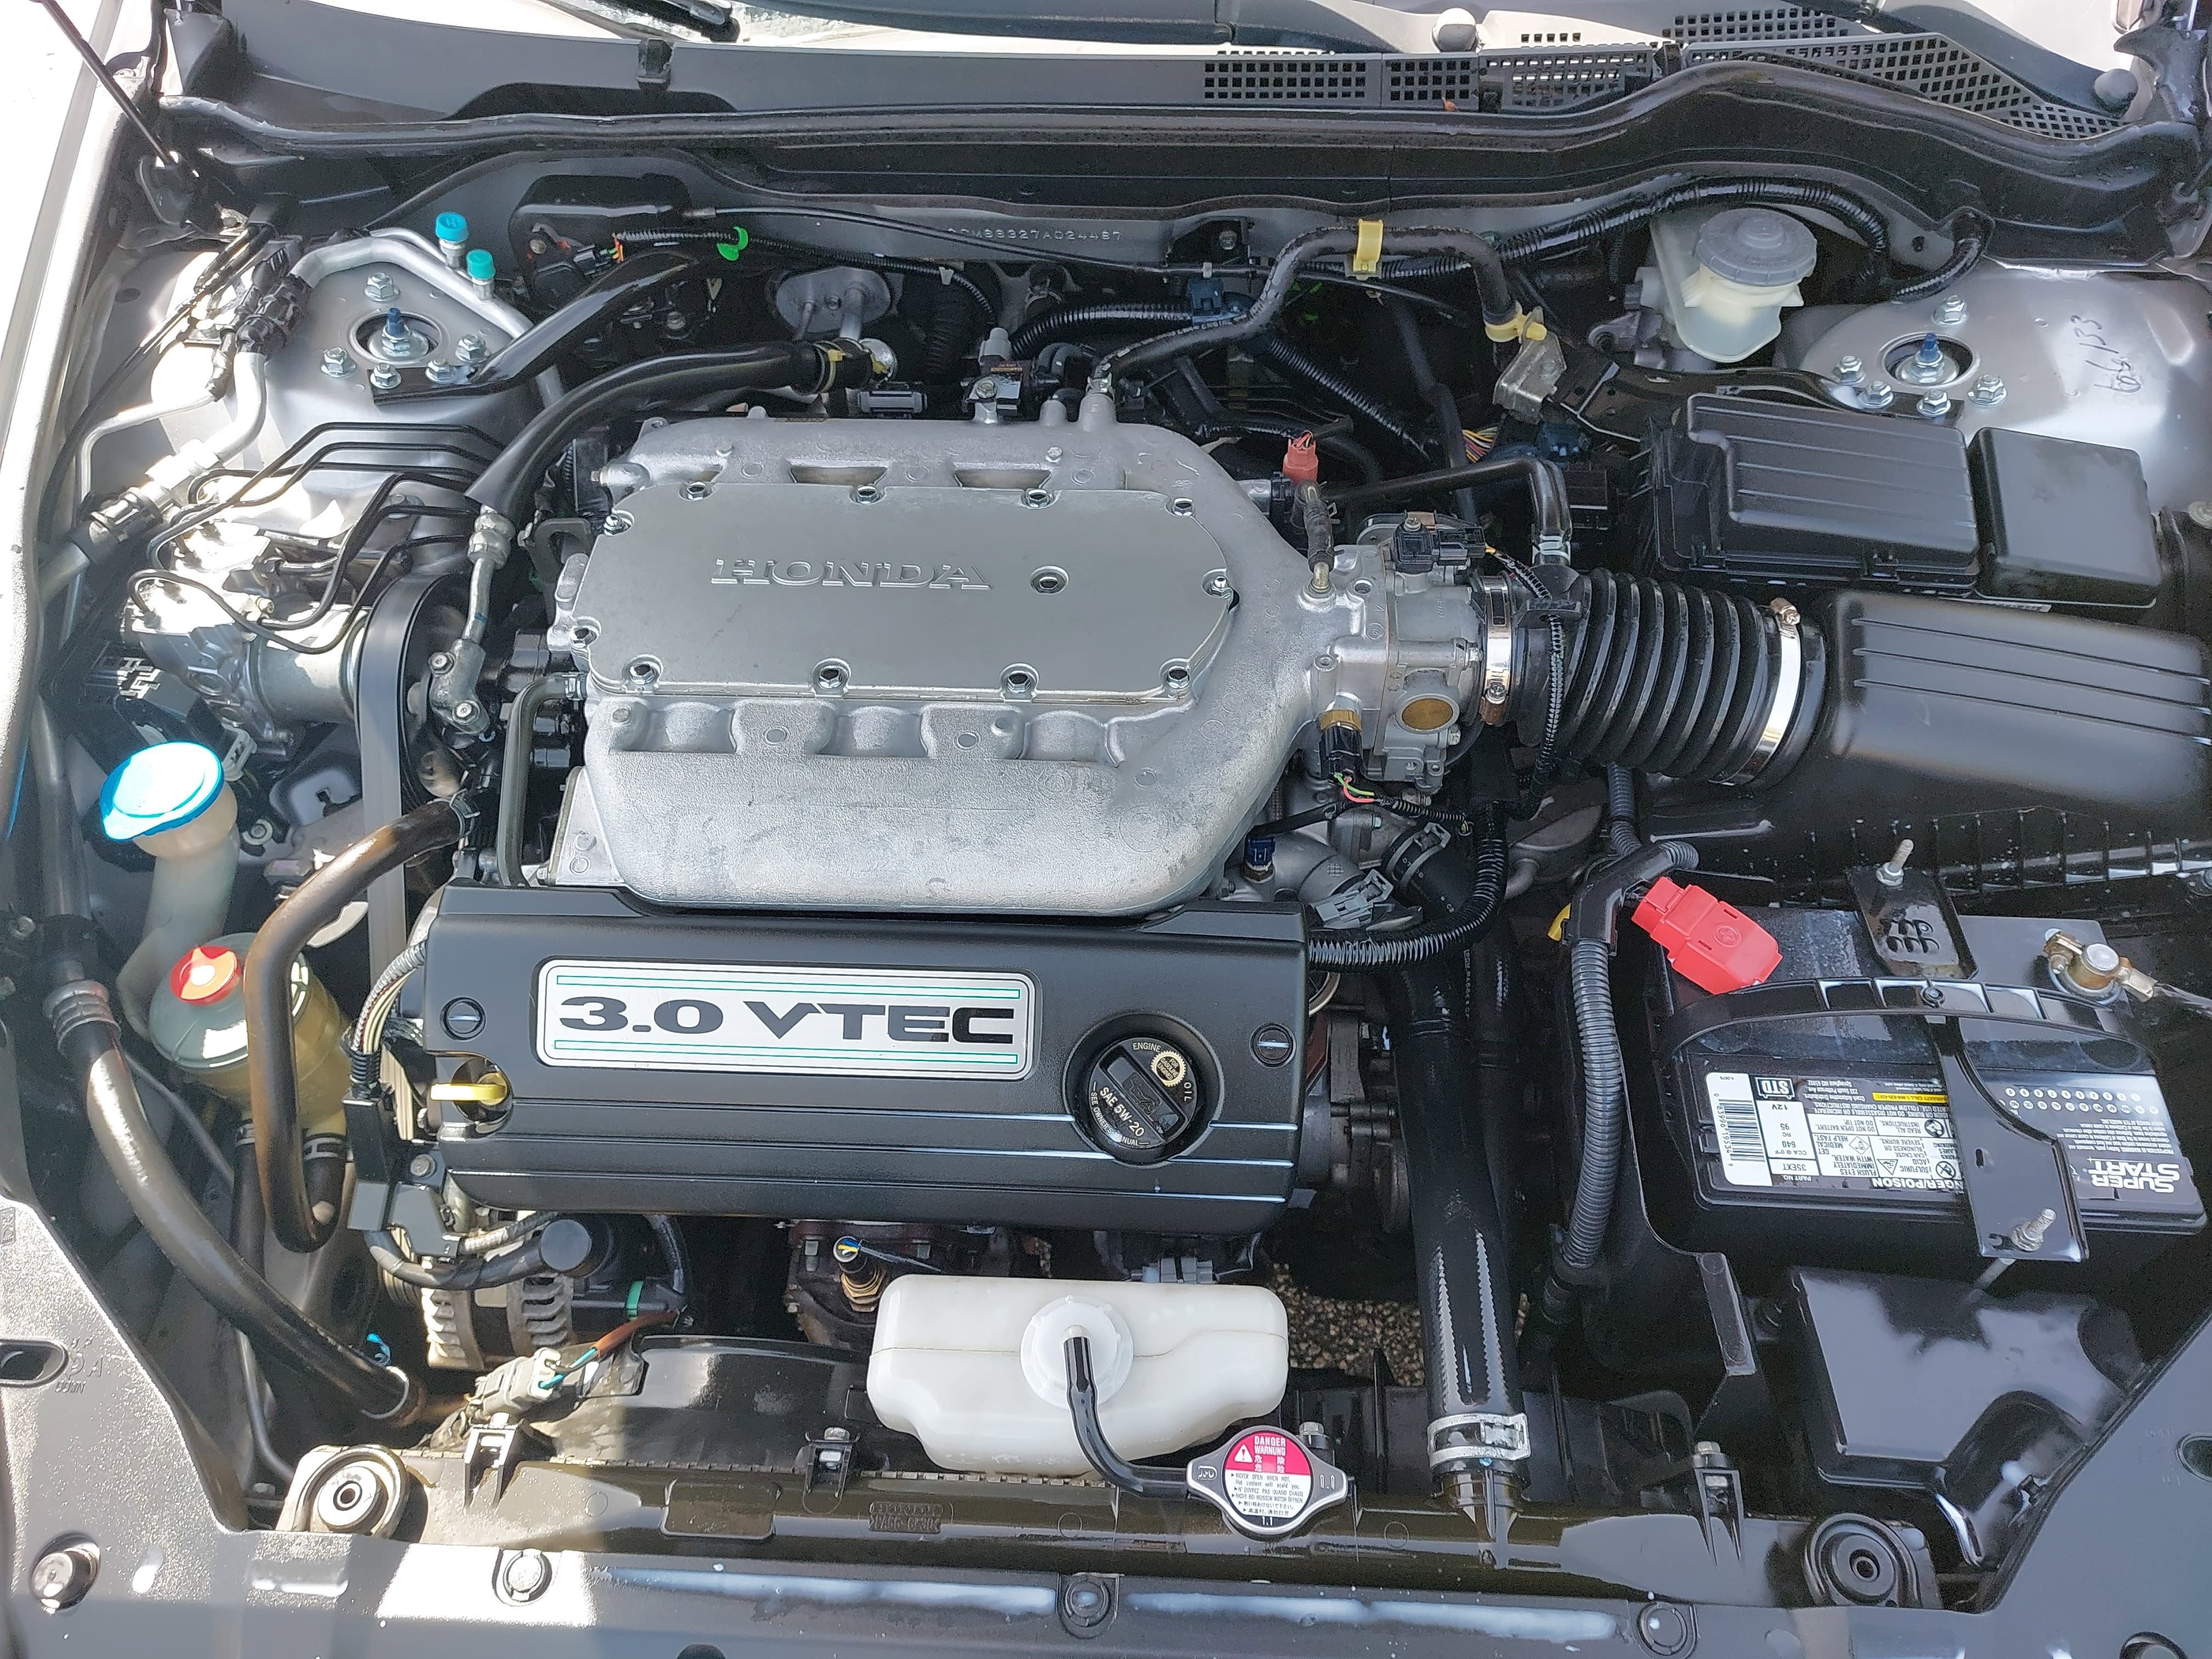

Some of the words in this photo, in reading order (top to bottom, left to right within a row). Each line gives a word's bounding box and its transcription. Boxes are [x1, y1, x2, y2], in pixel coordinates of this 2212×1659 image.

[711, 558, 991, 590] HONDA
[559, 996, 724, 1035] 3.0
[742, 1000, 1015, 1045] VTEC
[1157, 1063, 1173, 1080] ENGINES
[1160, 1058, 1179, 1077] GASOLINE
[1169, 1058, 1178, 1068] FOR
[1132, 1042, 1161, 1053] ENGINE
[1184, 1082, 1192, 1102] OIL
[1760, 1080, 1789, 1094] STD
[1093, 1107, 1113, 1133] OWNER'S
[1100, 1087, 1118, 1107] SAE
[1115, 1104, 1144, 1136] 5W-20
[1717, 1105, 1727, 1128] 83996
[1722, 1132, 1731, 1153] 19534
[1782, 1163, 1807, 1171] 35EXT
[1900, 1166, 1929, 1174] SULFURIC
[2091, 1174, 2174, 1193] SUPER
[1254, 1435, 1286, 1447] DANGER
[1254, 1444, 1286, 1456] WARNUNG
[1319, 1474, 1335, 1490] 1.1
[1262, 1516, 1273, 1526] 1.1
